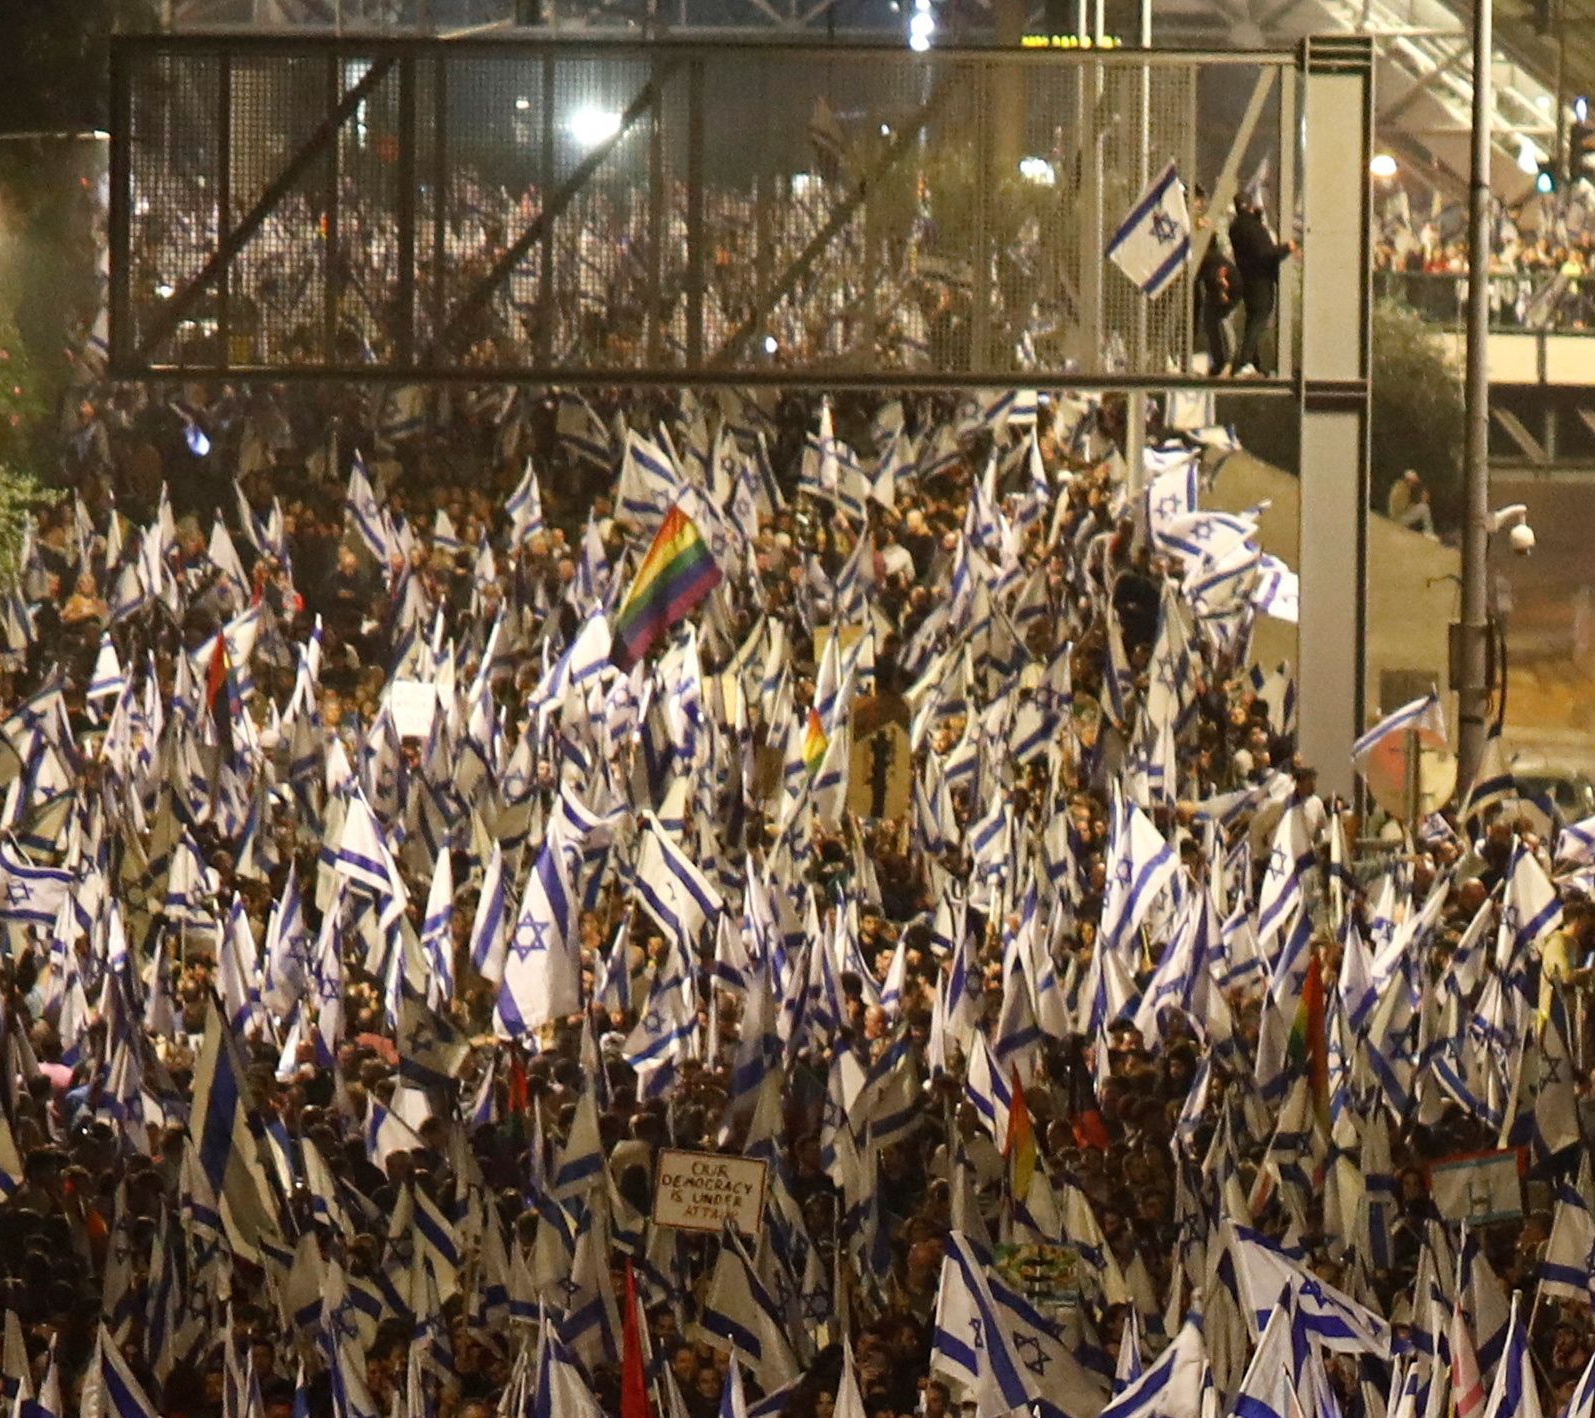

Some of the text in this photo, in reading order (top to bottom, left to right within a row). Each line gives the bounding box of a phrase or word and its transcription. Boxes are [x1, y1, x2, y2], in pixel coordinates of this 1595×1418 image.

[691, 1161, 729, 1178] OUR
[661, 1175, 754, 1195] DEMOCRACY
[670, 1187, 743, 1207] IS UNDER
[683, 1206, 739, 1221] ATTAK
